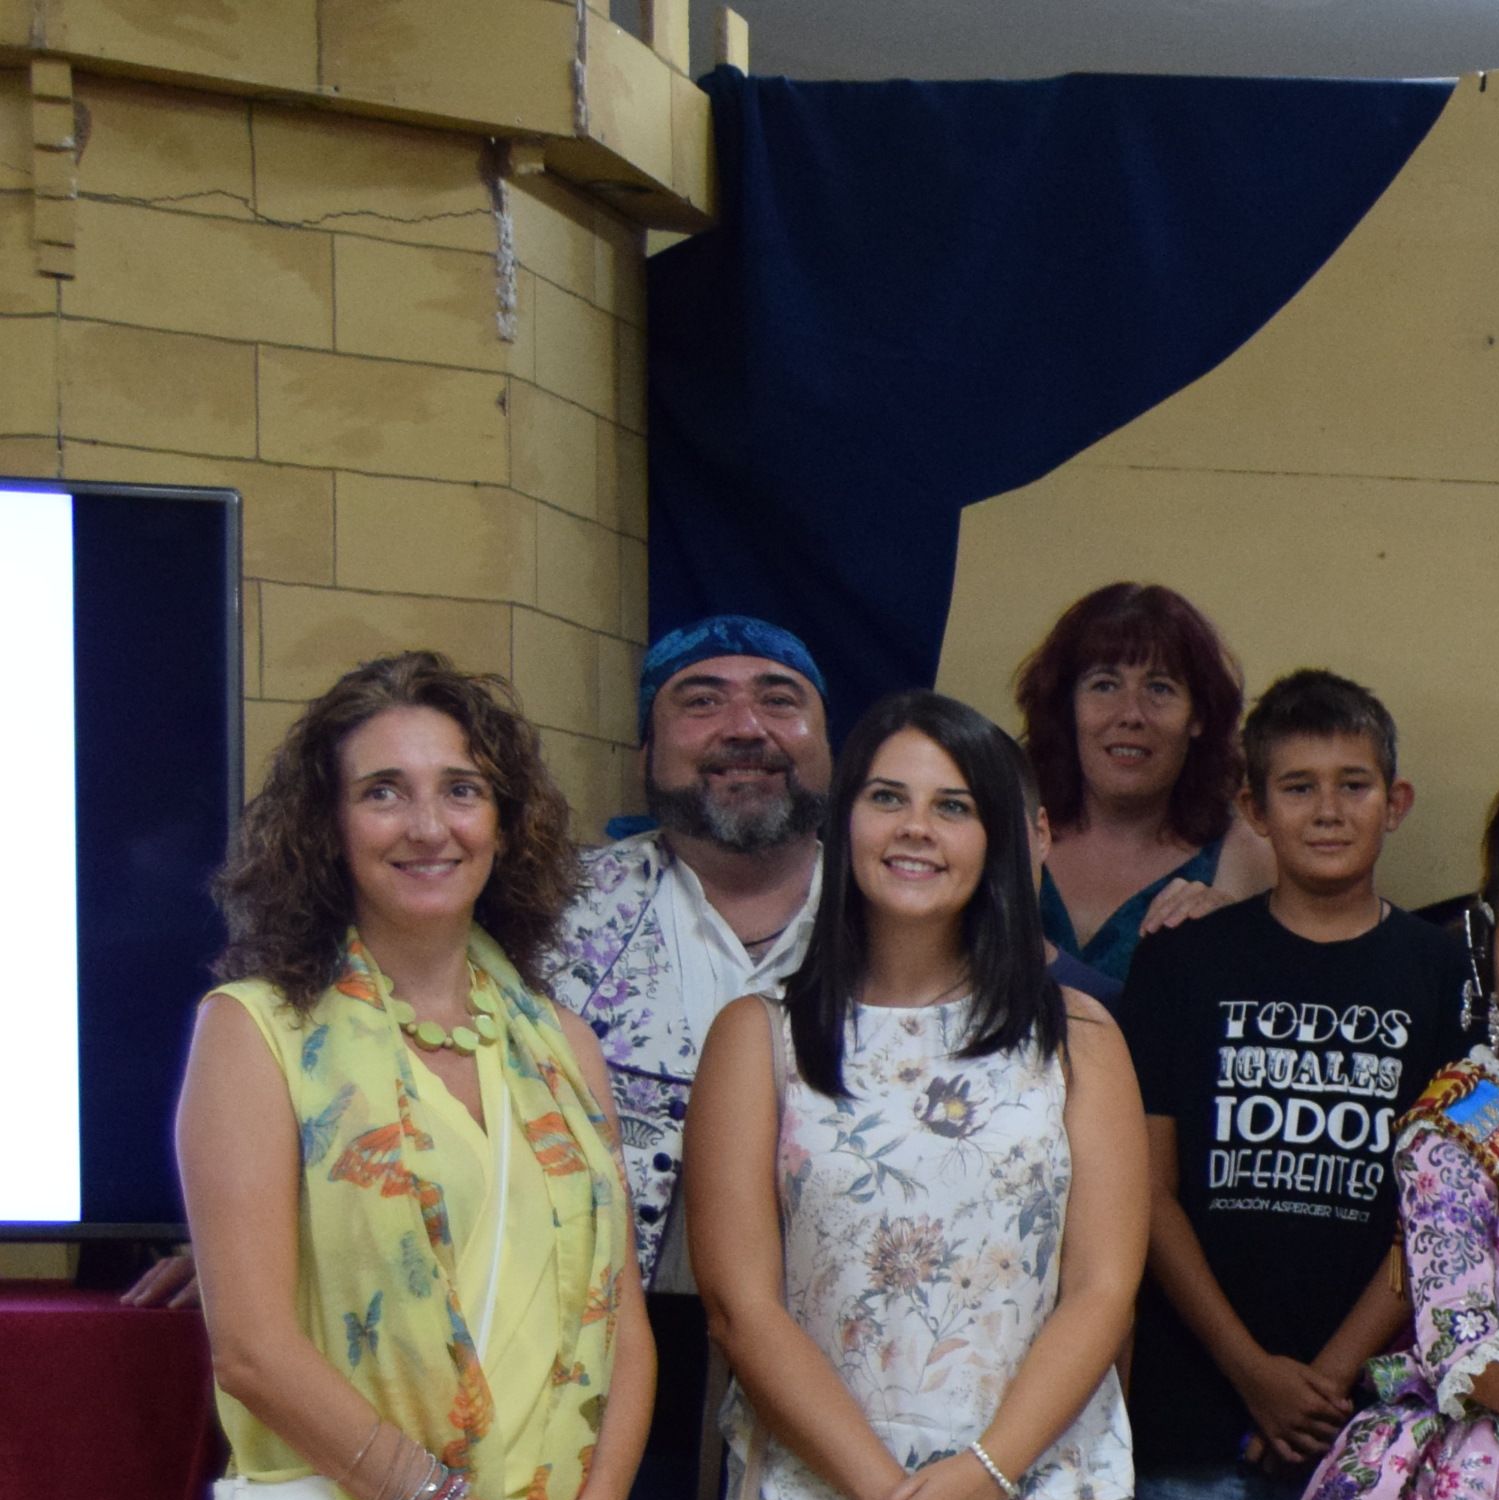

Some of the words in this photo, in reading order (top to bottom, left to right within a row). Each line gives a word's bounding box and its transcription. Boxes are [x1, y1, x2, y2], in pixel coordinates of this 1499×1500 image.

[1218, 1000, 1412, 1049] TODOS
[1216, 1046, 1403, 1100] IGUALES
[1214, 1095, 1395, 1153] TODOS
[1208, 1149, 1385, 1201] DIFERENTES
